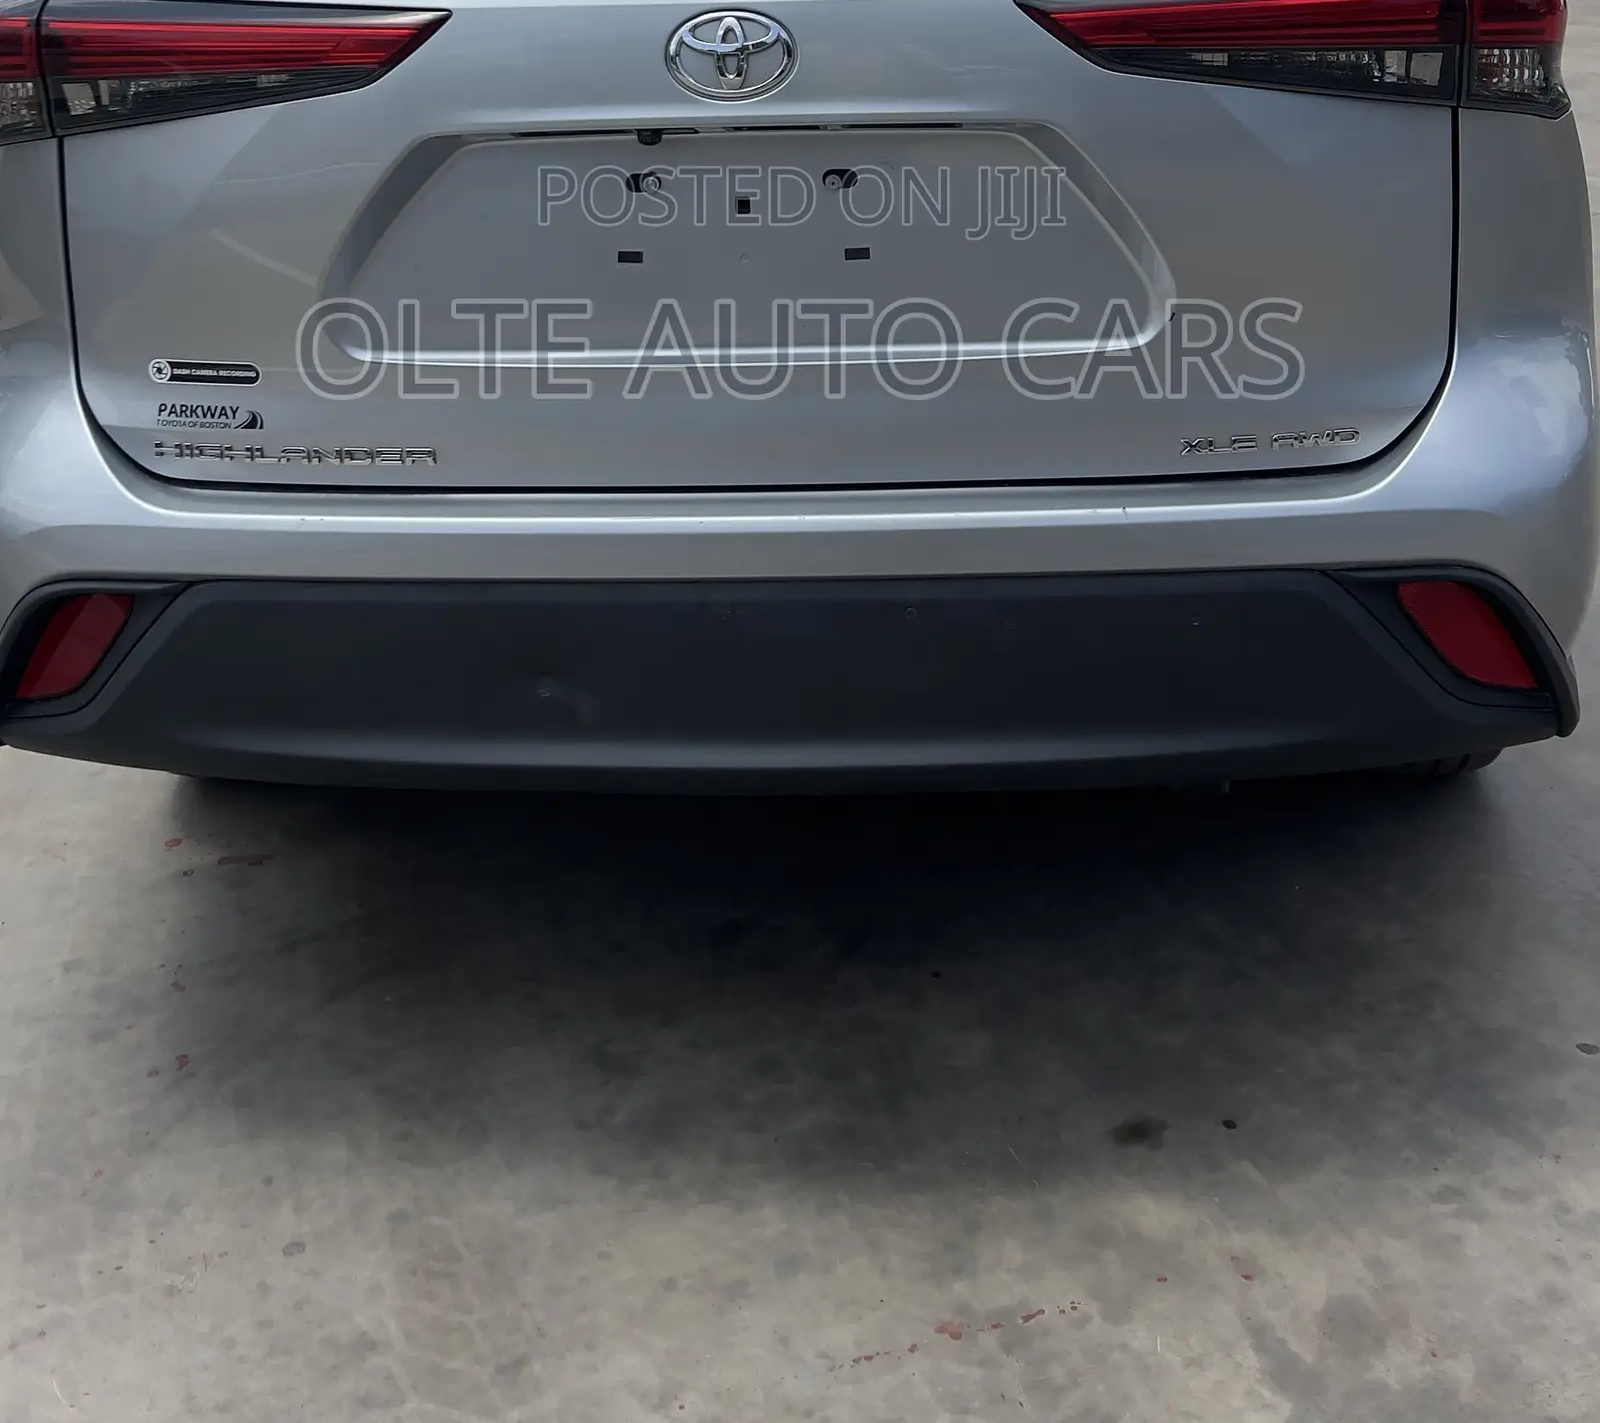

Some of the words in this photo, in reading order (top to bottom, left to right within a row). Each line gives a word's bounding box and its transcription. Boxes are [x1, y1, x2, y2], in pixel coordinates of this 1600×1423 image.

[191, 368, 218, 377] CAMERA
[157, 402, 240, 420] PARKWAY
[156, 418, 187, 428] TOYOTA
[187, 419, 200, 428] OF
[200, 420, 232, 430] BOSTON
[1179, 435, 1258, 456] XLE
[1270, 427, 1362, 451] AWD
[154, 439, 438, 467] HIGHLANDER
